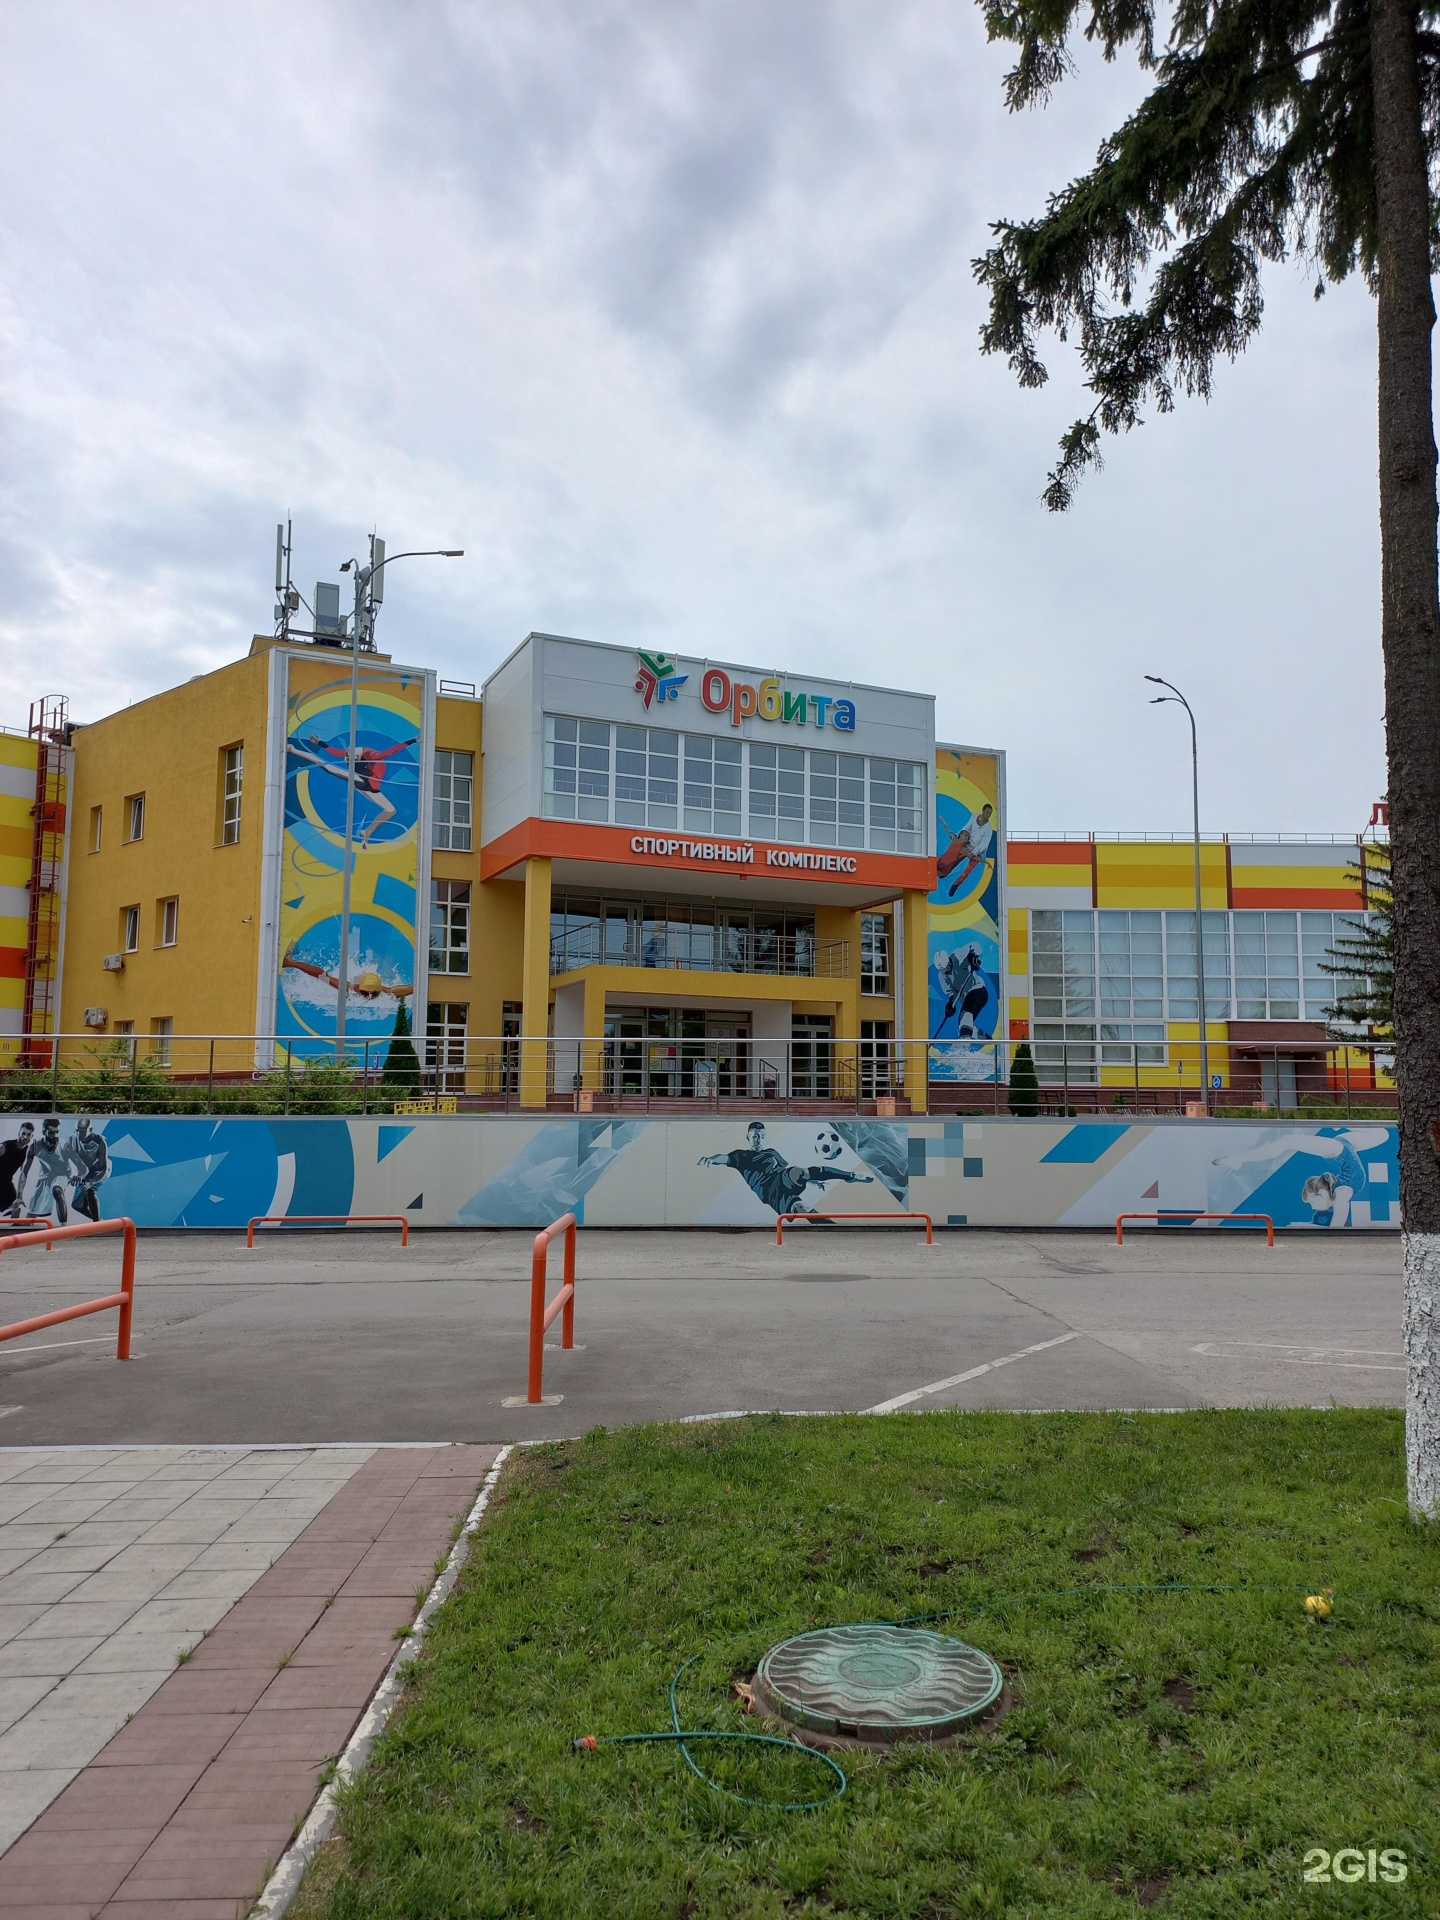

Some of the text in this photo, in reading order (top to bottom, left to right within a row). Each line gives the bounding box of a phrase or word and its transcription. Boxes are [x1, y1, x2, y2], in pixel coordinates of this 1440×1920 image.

[701, 669, 856, 732] Орбита
[630, 836, 857, 873] СПОРТИВНЫЙ КОМПЛЕКС
